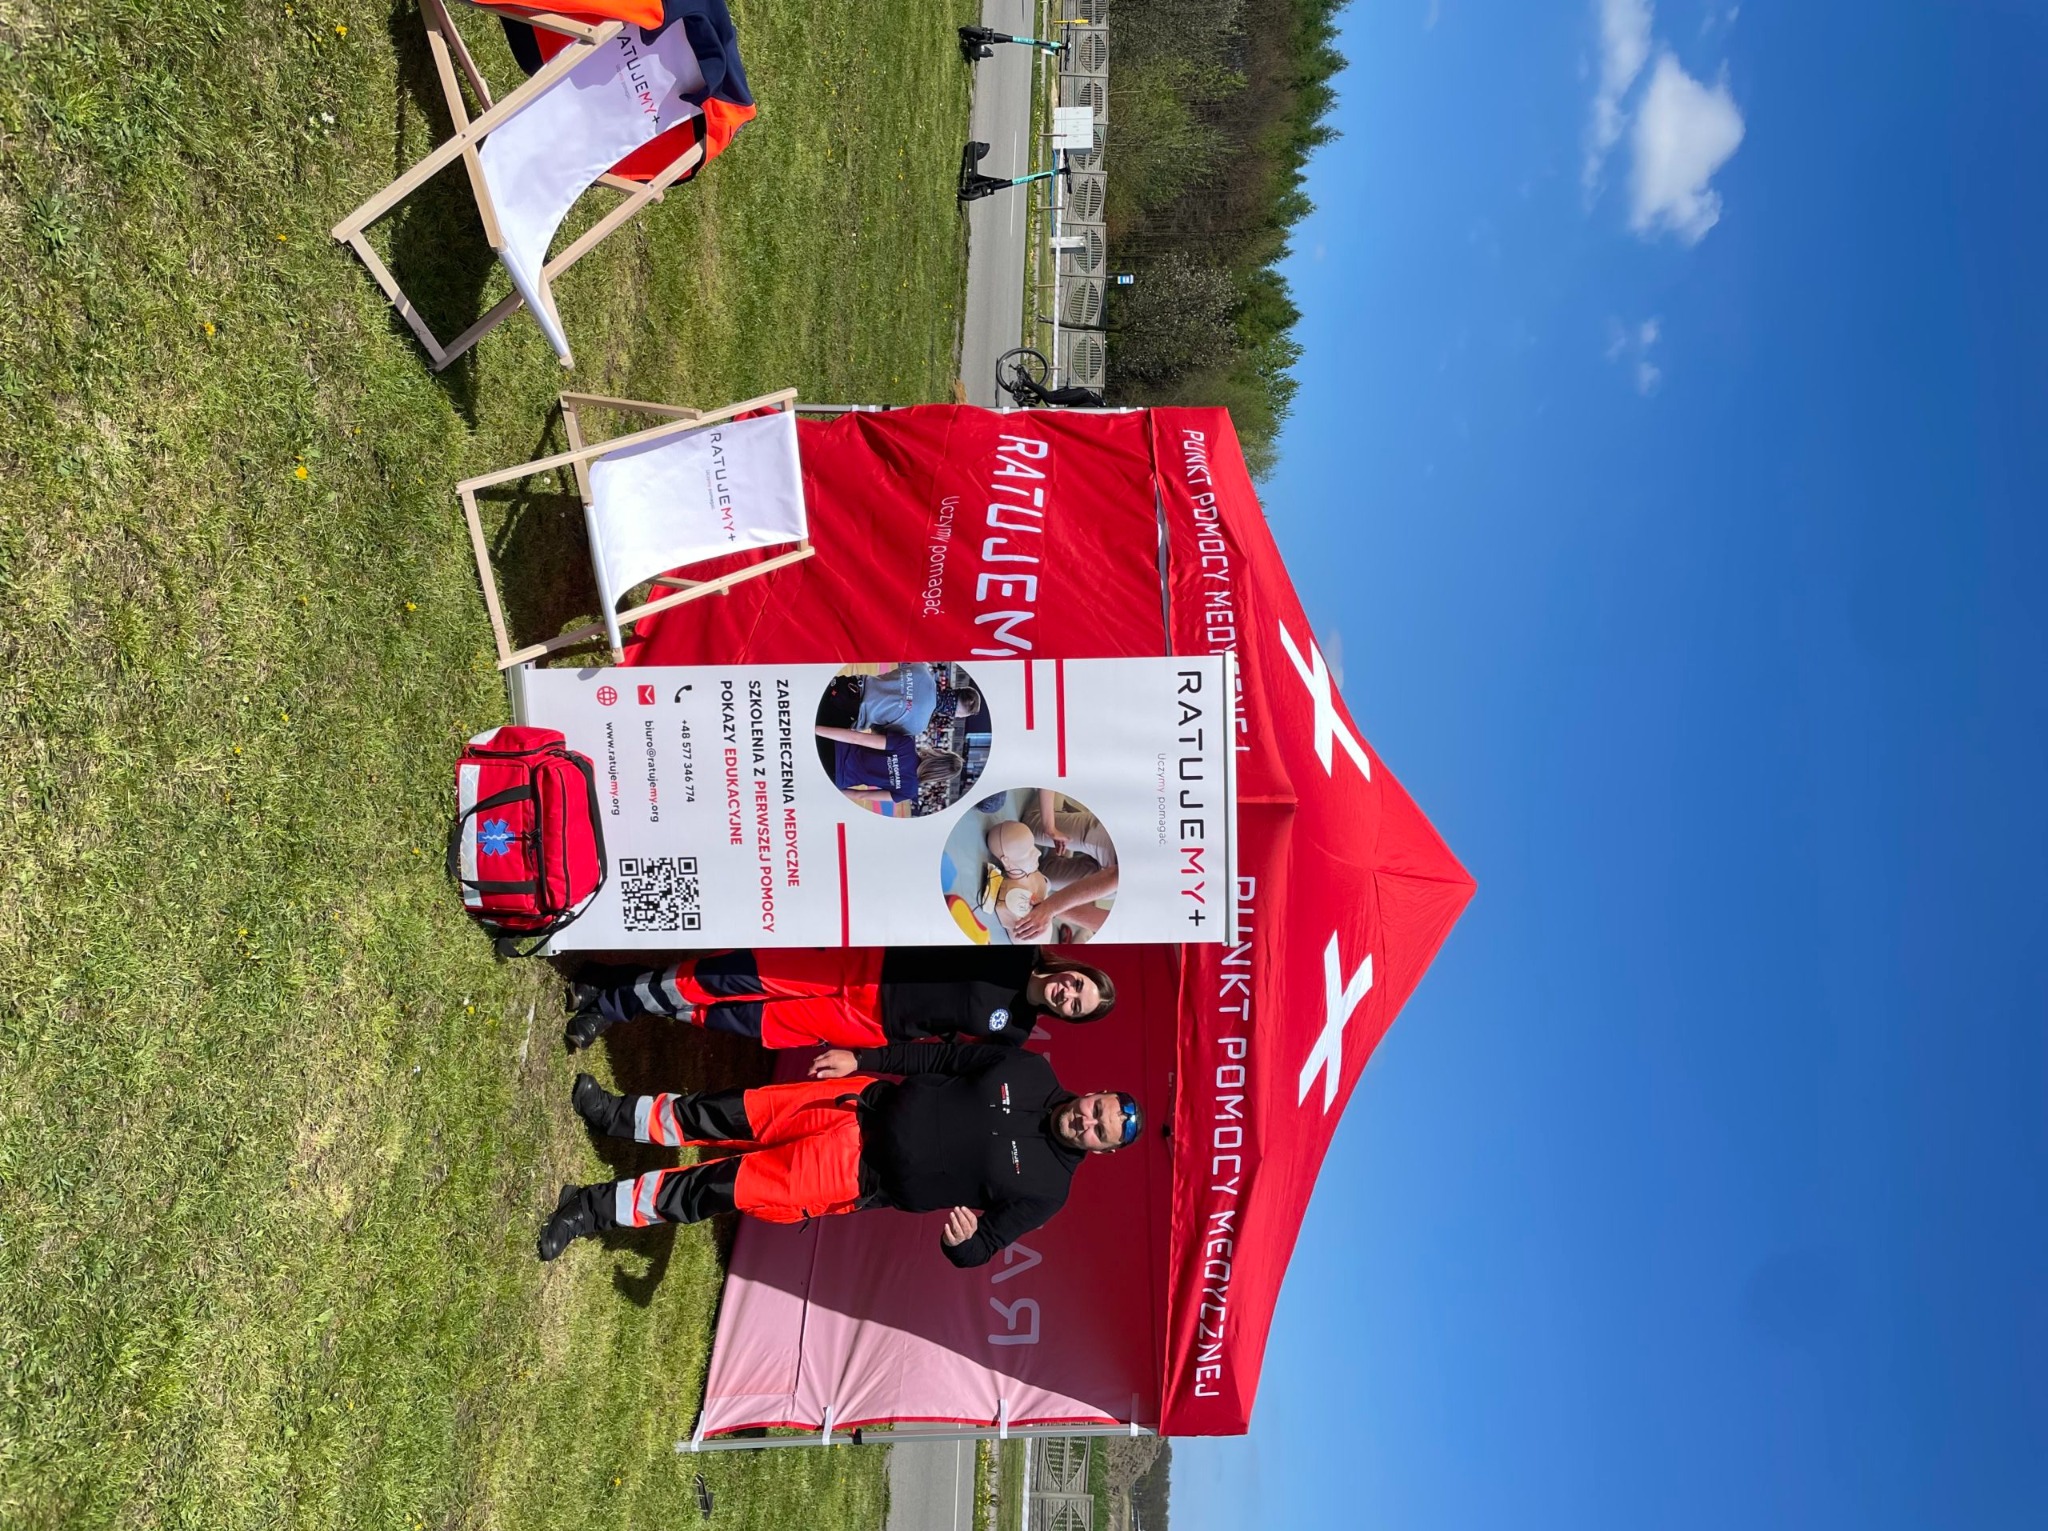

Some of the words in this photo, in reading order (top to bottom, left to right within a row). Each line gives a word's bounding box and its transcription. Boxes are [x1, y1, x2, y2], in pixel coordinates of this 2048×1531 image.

[616, 27, 660, 124] ATUJEMY+
[1182, 430, 1212, 486] PUNKT
[930, 496, 960, 542] Uczymy
[970, 434, 1048, 656] RATUJEM
[1190, 492, 1230, 582] POMOCY
[922, 545, 948, 618] pomagać.
[681, 720, 691, 739] +48
[682, 742, 692, 760] 577
[720, 680, 736, 744] POKAZY
[748, 680, 766, 764] SZKOLENIA
[776, 680, 795, 804] ZABEZPIECZENIA
[606, 722, 622, 816] www.ratujemy.org
[644, 720, 661, 822] biuro@ratujemy.org
[684, 762, 694, 782] 346
[685, 785, 695, 803] 774
[724, 748, 742, 845] EDUKACYJNE
[754, 768, 766, 777] Z
[1156, 753, 1166, 793] Uczymy
[754, 780, 772, 862] PIERWSZEJ
[784, 808, 800, 887] MEDYCZNE
[760, 866, 774, 933] POMOCY
[1211, 1038, 1247, 1194] POMOCY
[1194, 1211, 1236, 1398] MEDYCZNEJ
